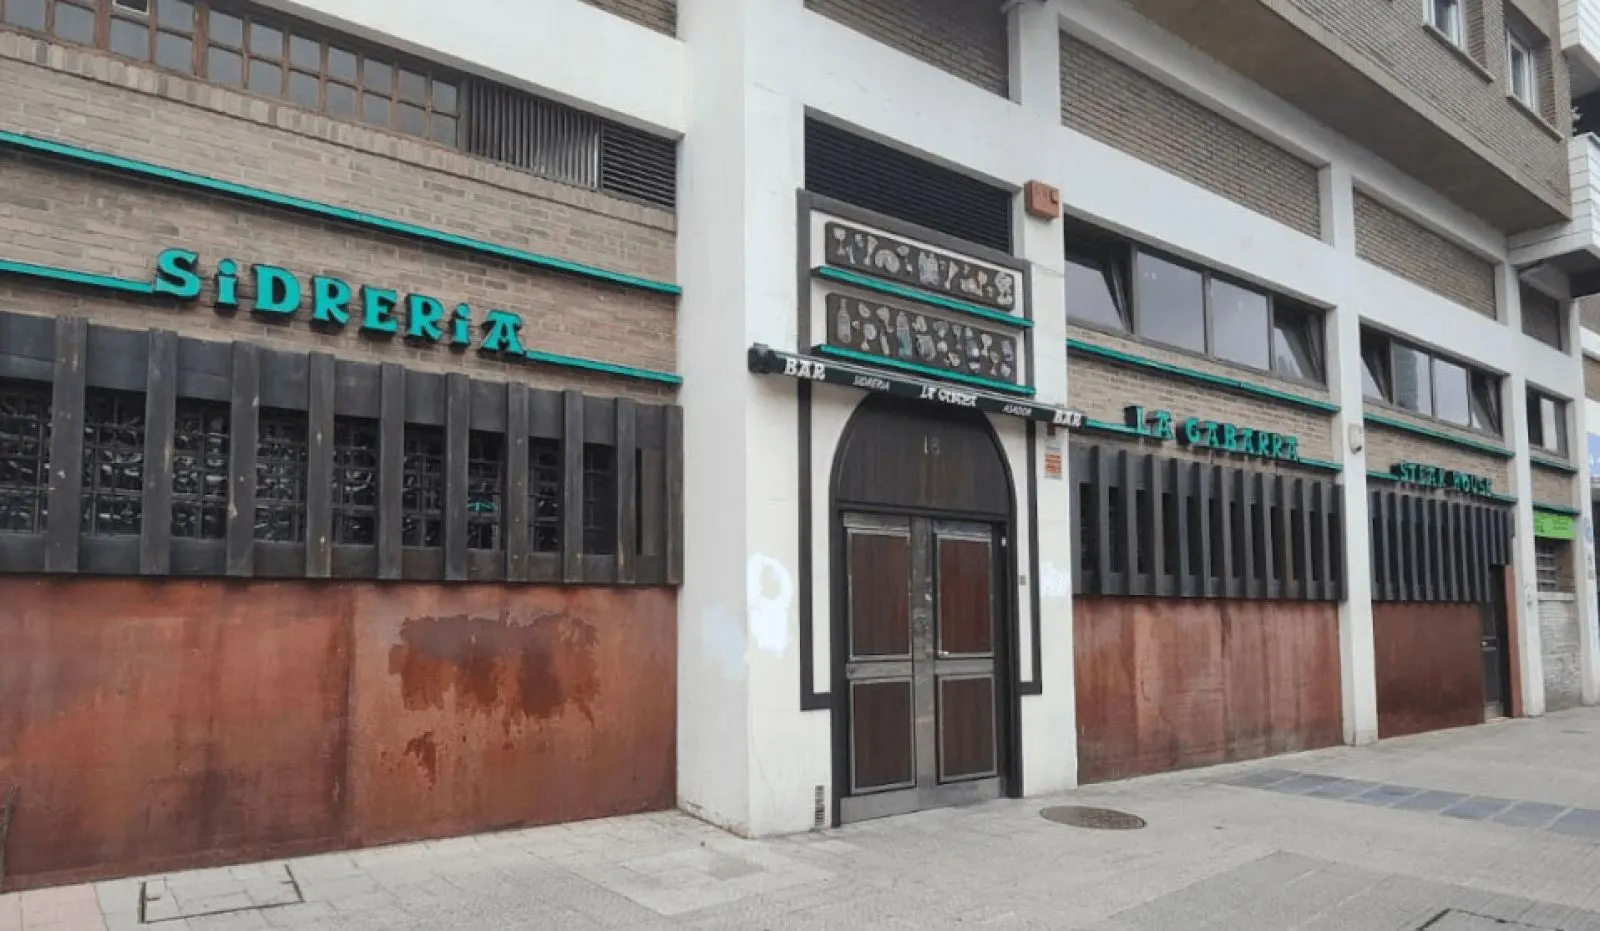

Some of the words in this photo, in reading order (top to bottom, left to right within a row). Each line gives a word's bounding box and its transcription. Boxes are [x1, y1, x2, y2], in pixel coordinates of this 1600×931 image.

[784, 357, 826, 381] BAR
[1053, 408, 1083, 427] BAR
[1126, 405, 1173, 441] LA
[1179, 416, 1299, 461] GABARRA
